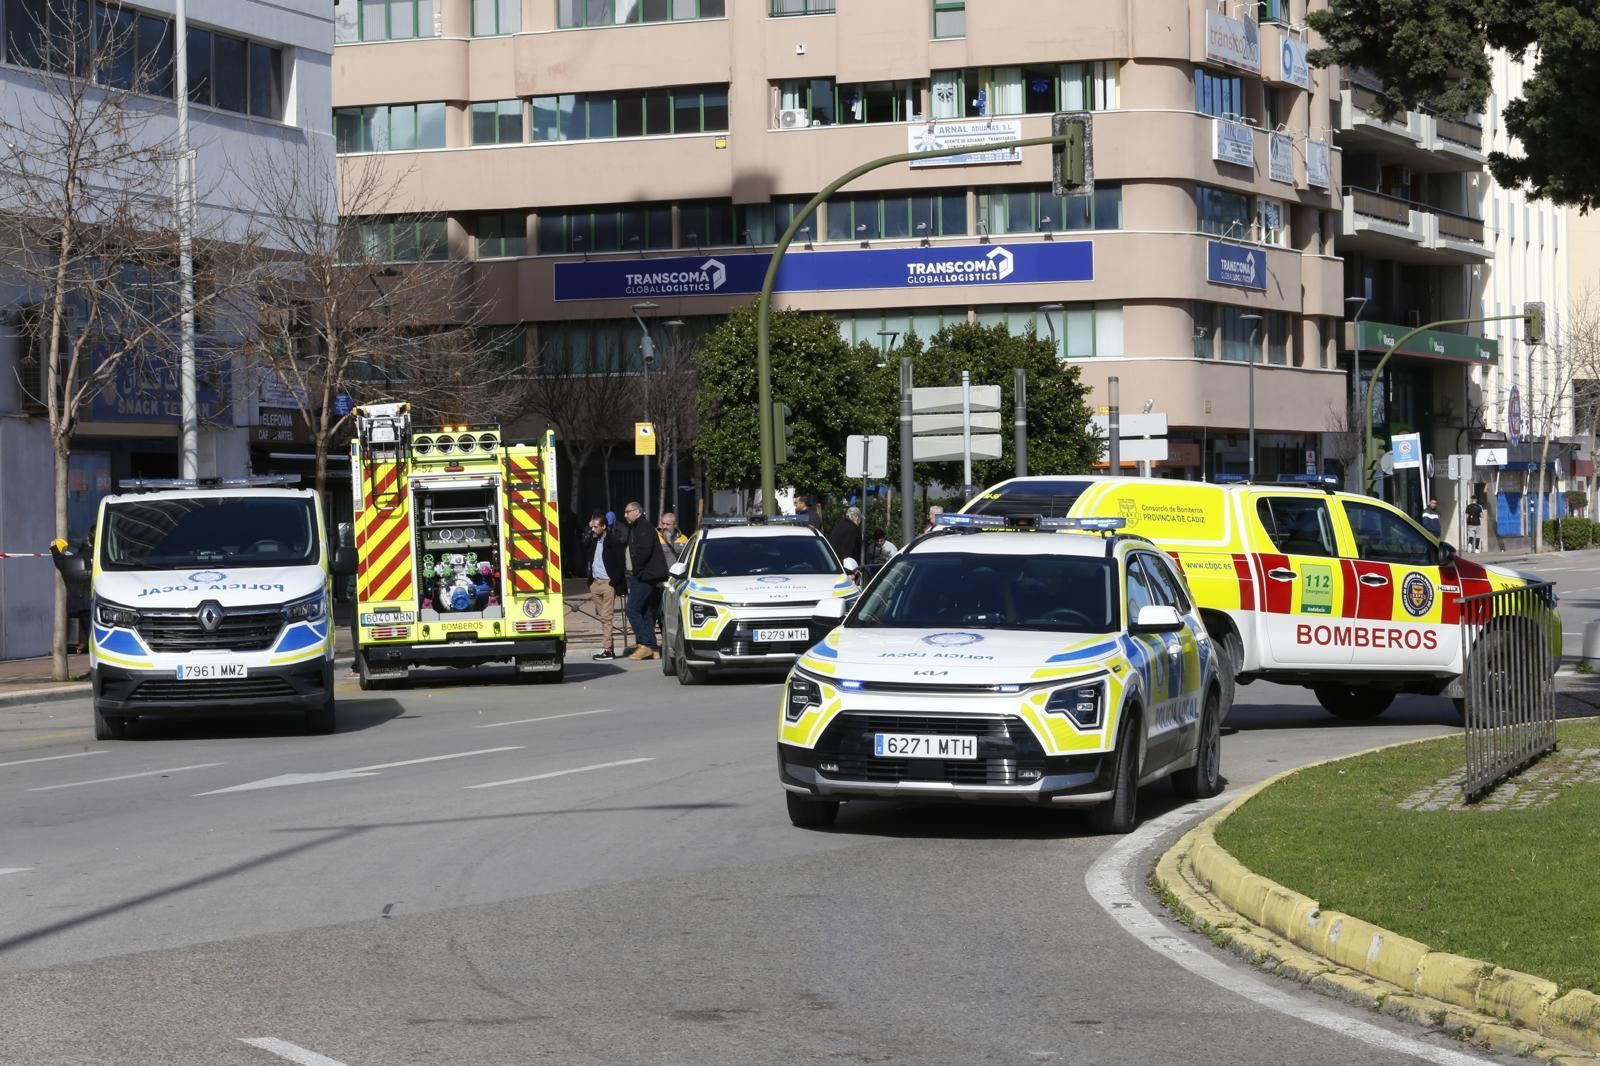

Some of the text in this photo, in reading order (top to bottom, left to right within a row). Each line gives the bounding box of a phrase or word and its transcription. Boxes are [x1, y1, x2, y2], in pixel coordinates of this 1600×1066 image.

[939, 125, 968, 134] ARNAL
[907, 260, 997, 275] TRANSCOMA
[1221, 258, 1250, 274] TRANSCOMA
[626, 271, 709, 285] TRANSCOMA
[118, 399, 159, 415] SNACK
[1141, 504, 1168, 512] Consorcio
[1177, 505, 1203, 513] Bomberos
[1143, 513, 1176, 522] PROVINCIA
[1186, 561, 1232, 570] www.cbpc.es
[1306, 575, 1330, 588] 112
[366, 612, 412, 624] 6040 MBN
[441, 622, 484, 631] BOMBEROS
[760, 629, 807, 640] 6279 MTH
[1296, 624, 1437, 650] BOMBEROS
[185, 664, 244, 677] 7961 MMZ
[887, 737, 972, 756] 6271 MTH
